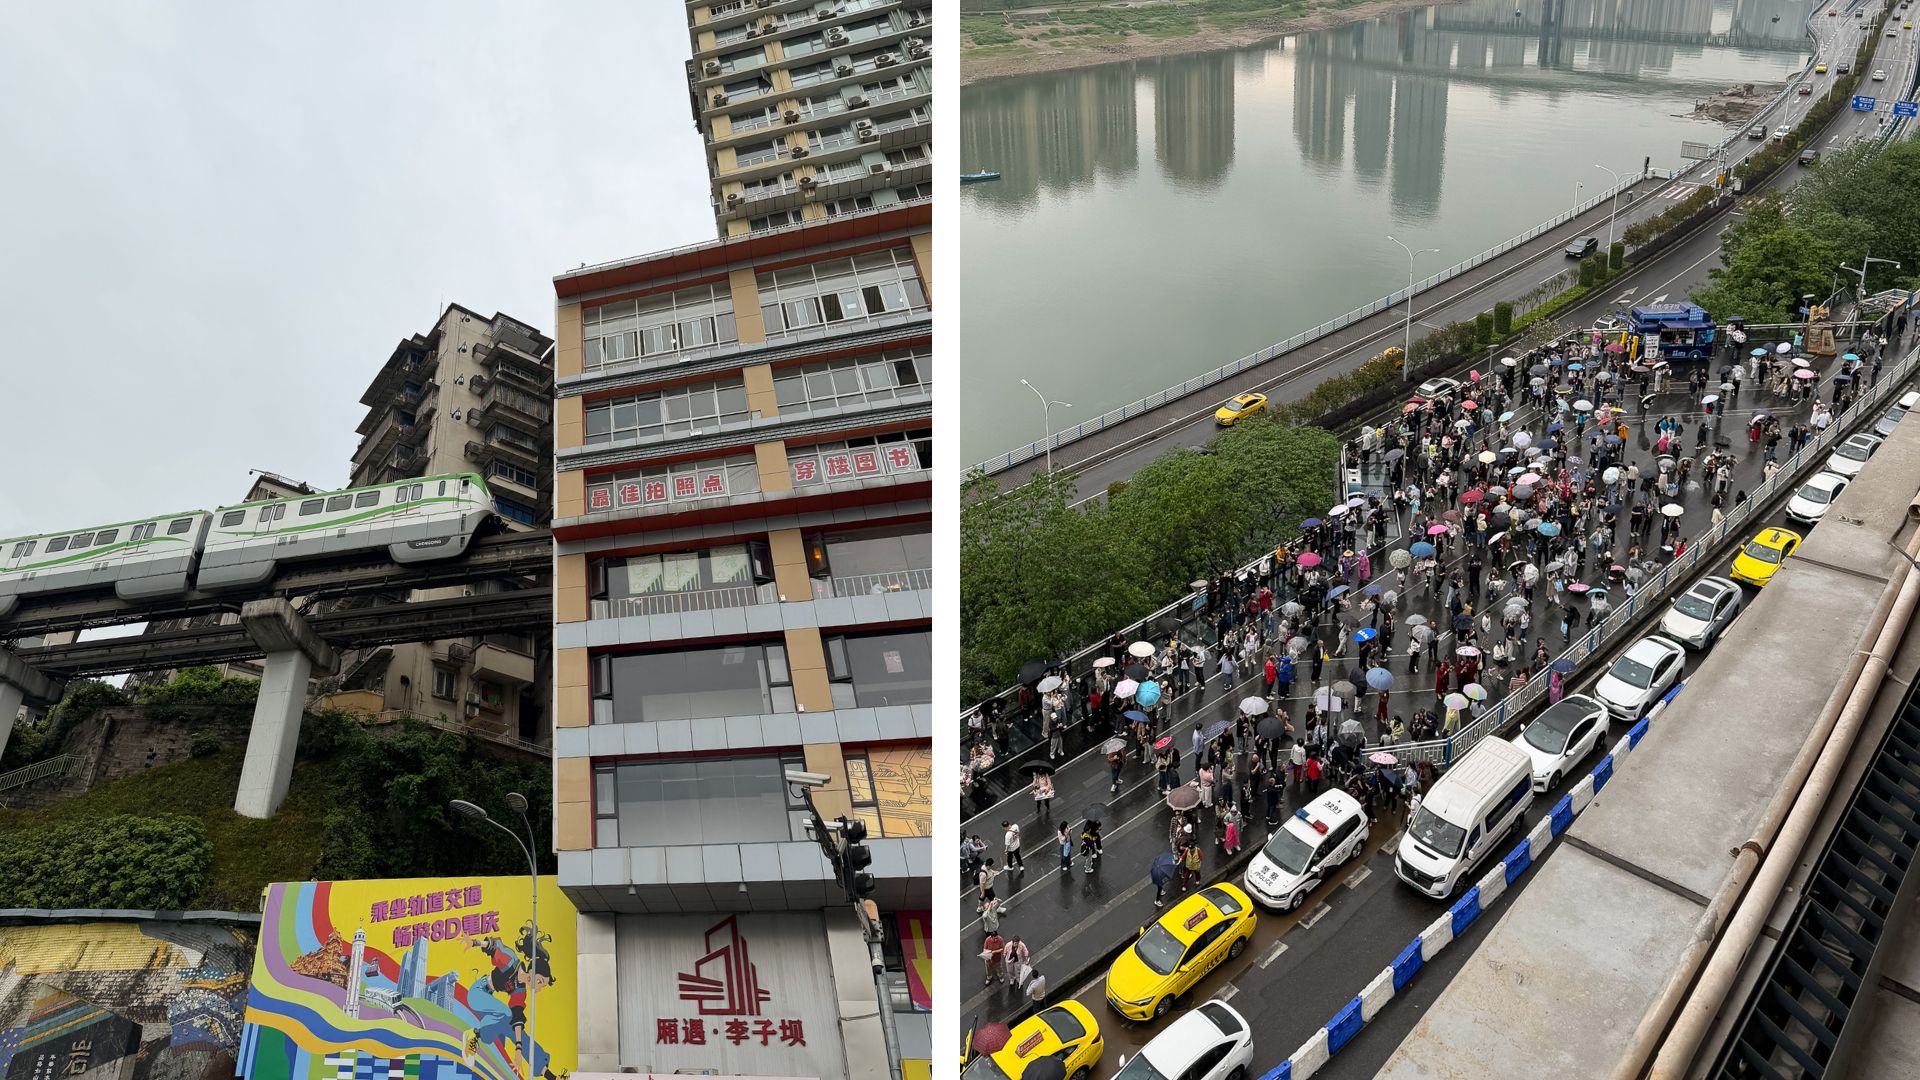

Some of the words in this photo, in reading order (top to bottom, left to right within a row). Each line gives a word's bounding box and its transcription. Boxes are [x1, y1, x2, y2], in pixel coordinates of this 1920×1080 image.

[590, 474, 725, 507] 最佳拍照点
[793, 448, 912, 480] 穿楼图书
[1324, 800, 1342, 814] 3291
[1253, 871, 1274, 887] POLICE
[1260, 865, 1279, 882] 警察
[371, 885, 482, 923] 乘坐轨道交通
[393, 911, 500, 948] 畅游8D重庆
[656, 1017, 807, 1047] 厢遇·李子坝
